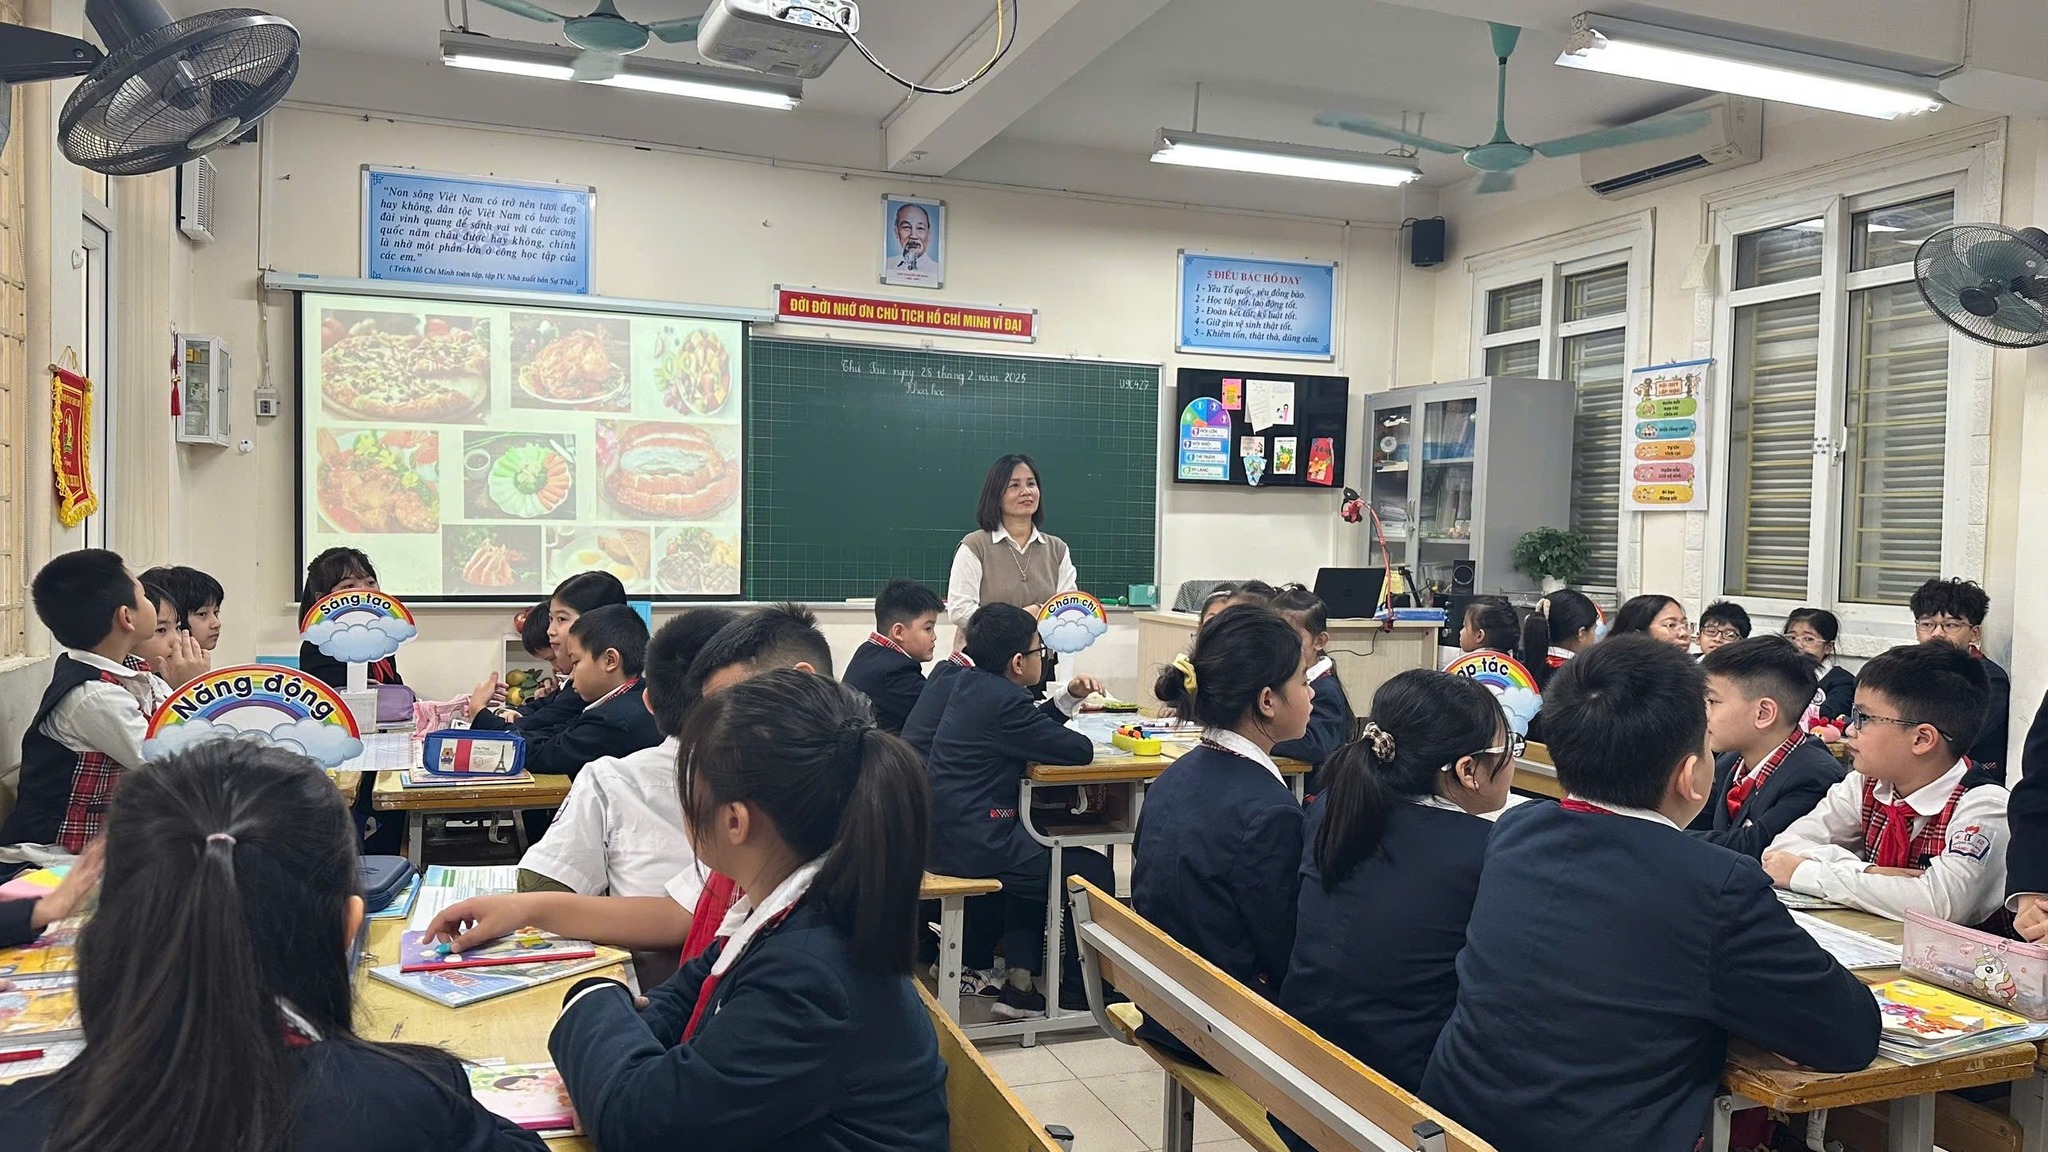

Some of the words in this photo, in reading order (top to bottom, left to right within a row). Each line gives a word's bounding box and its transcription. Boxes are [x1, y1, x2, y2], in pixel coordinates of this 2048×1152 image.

[380, 198, 397, 211] hay
[401, 200, 432, 213] không,
[436, 204, 453, 214] dân
[458, 206, 472, 215] tộc
[477, 207, 495, 217] Việt
[499, 210, 520, 220] Nam
[524, 212, 535, 221] có
[539, 213, 559, 223] bước
[564, 216, 576, 225] tới
[412, 189, 434, 201] sông
[439, 191, 456, 201] Việt
[461, 193, 482, 204] Nam
[487, 196, 497, 205] có
[501, 198, 515, 207] trở
[519, 199, 535, 209] nên
[539, 202, 556, 211] tươi
[560, 203, 576, 214] đẹp
[380, 211, 394, 221] đài
[400, 214, 419, 223] vinh
[423, 218, 451, 227] quang
[455, 217, 468, 227] để
[470, 220, 492, 230] sánh
[497, 223, 509, 231] vai
[514, 224, 527, 233] với
[531, 225, 546, 234] các
[549, 229, 576, 239] cường
[380, 224, 404, 235] quốc
[409, 228, 429, 237] năm
[434, 229, 458, 239] châu
[462, 231, 485, 242] được
[490, 234, 507, 245] hay
[512, 235, 544, 248] không,
[549, 239, 575, 249] chính
[380, 237, 389, 246] là
[394, 239, 413, 248] nhờ
[416, 241, 434, 250] một
[466, 244, 481, 254] lớn
[485, 246, 492, 255] ở
[495, 247, 516, 258] công
[521, 249, 537, 259] học
[541, 251, 556, 262] tập
[559, 252, 575, 262] của
[380, 250, 395, 260] các
[790, 296, 809, 312] ĐỜI
[811, 298, 830, 314] ĐỜI
[833, 301, 856, 316] NHỚ
[859, 304, 874, 318] ƠN
[876, 303, 898, 320] CHỦ
[900, 308, 923, 324] TỊCH
[926, 308, 940, 324] HỒ
[943, 311, 960, 326] CHÍ
[963, 314, 990, 328] MINH
[993, 315, 1003, 330] VĨ
[1004, 318, 1021, 333] ĐẠI
[937, 365, 964, 387] tháng
[967, 370, 974, 381] 2
[1004, 372, 1027, 384] 2025
[320, 594, 360, 614] Sáng
[366, 593, 391, 609] tạo
[1482, 656, 1509, 676] tác
[171, 676, 251, 720] Năng
[264, 674, 335, 720] động
